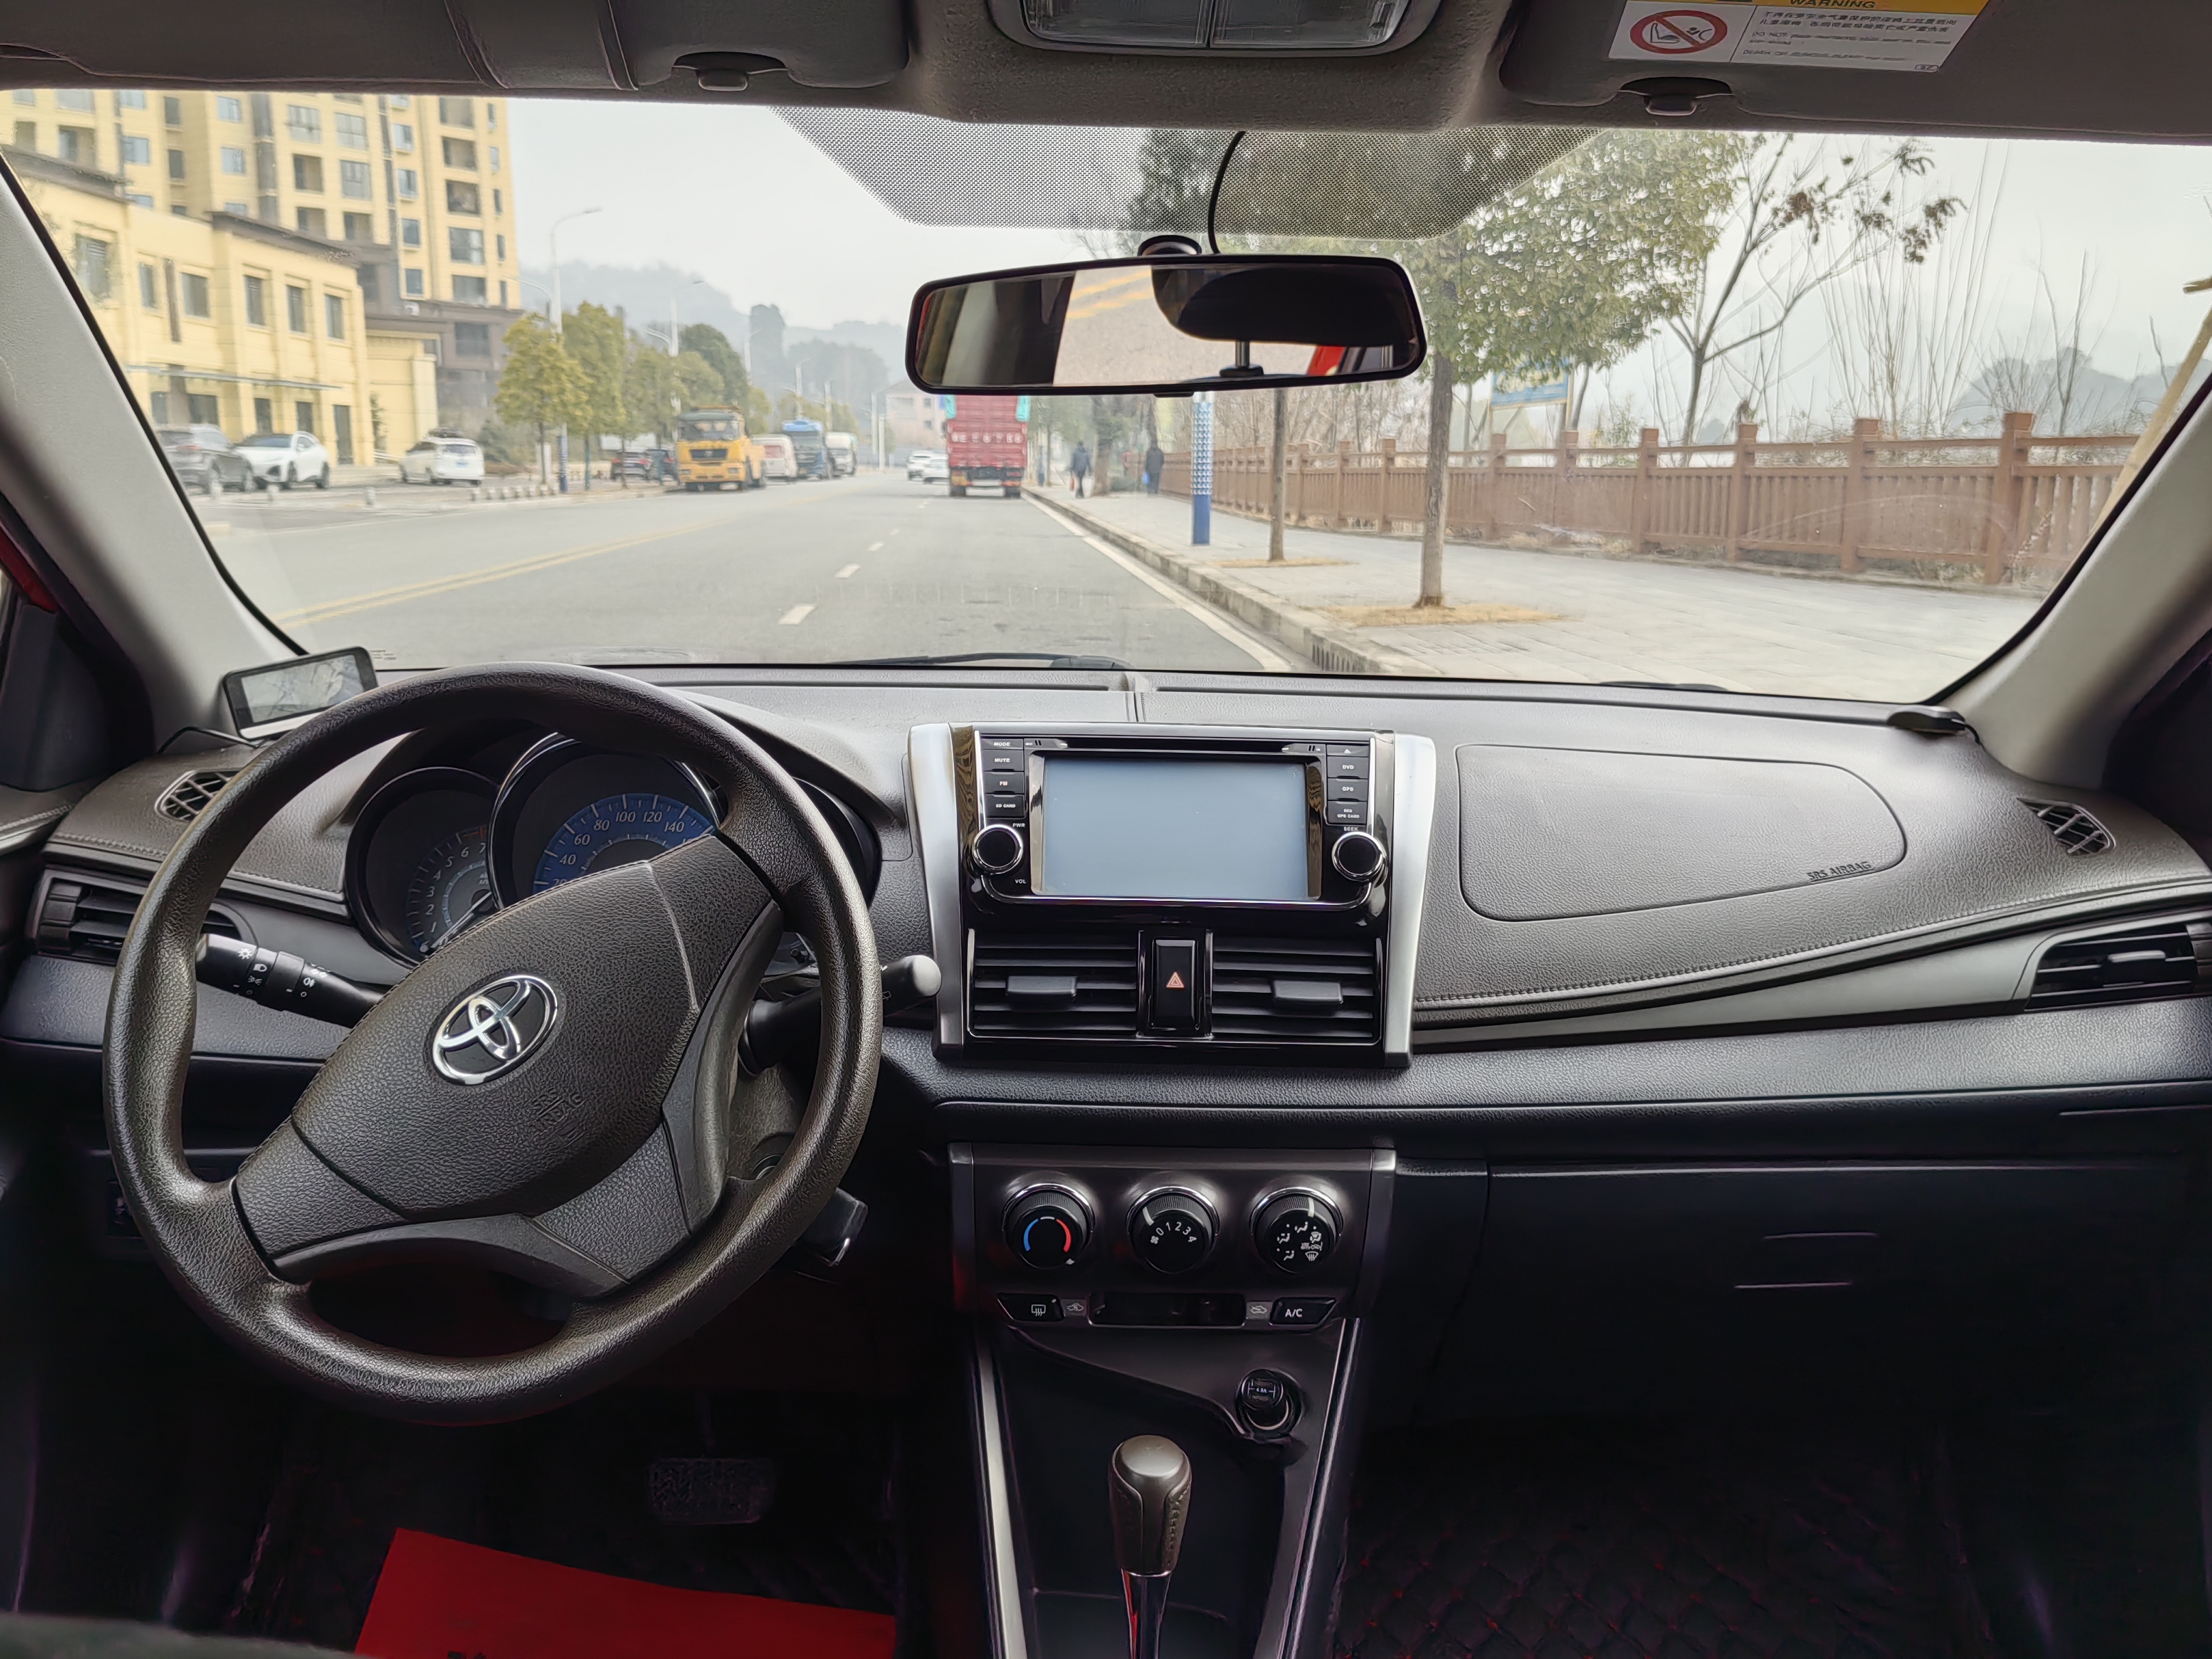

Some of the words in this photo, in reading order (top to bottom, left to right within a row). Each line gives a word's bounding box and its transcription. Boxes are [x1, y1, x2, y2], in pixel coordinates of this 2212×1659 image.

[1790, 0, 1876, 8] WARNING
[616, 812, 636, 822] 100
[643, 812, 663, 822] 120
[594, 819, 610, 831] 80
[664, 821, 685, 832] 140
[574, 834, 590, 845] 60
[461, 847, 469, 858] 6
[479, 842, 486, 853] 7
[445, 856, 454, 867] 5
[559, 854, 577, 865] 40
[433, 870, 441, 881] 4
[1806, 869, 1829, 880] SRS
[1829, 861, 1872, 875] AIRBAG
[426, 886, 435, 898] 3
[425, 904, 434, 915] 2
[430, 921, 436, 933] 1
[1156, 1227, 1164, 1236] 0
[1165, 1222, 1171, 1231] 1
[1175, 1222, 1182, 1231] 2
[1182, 1226, 1191, 1235] 3
[1285, 1308, 1303, 1318] A/C
